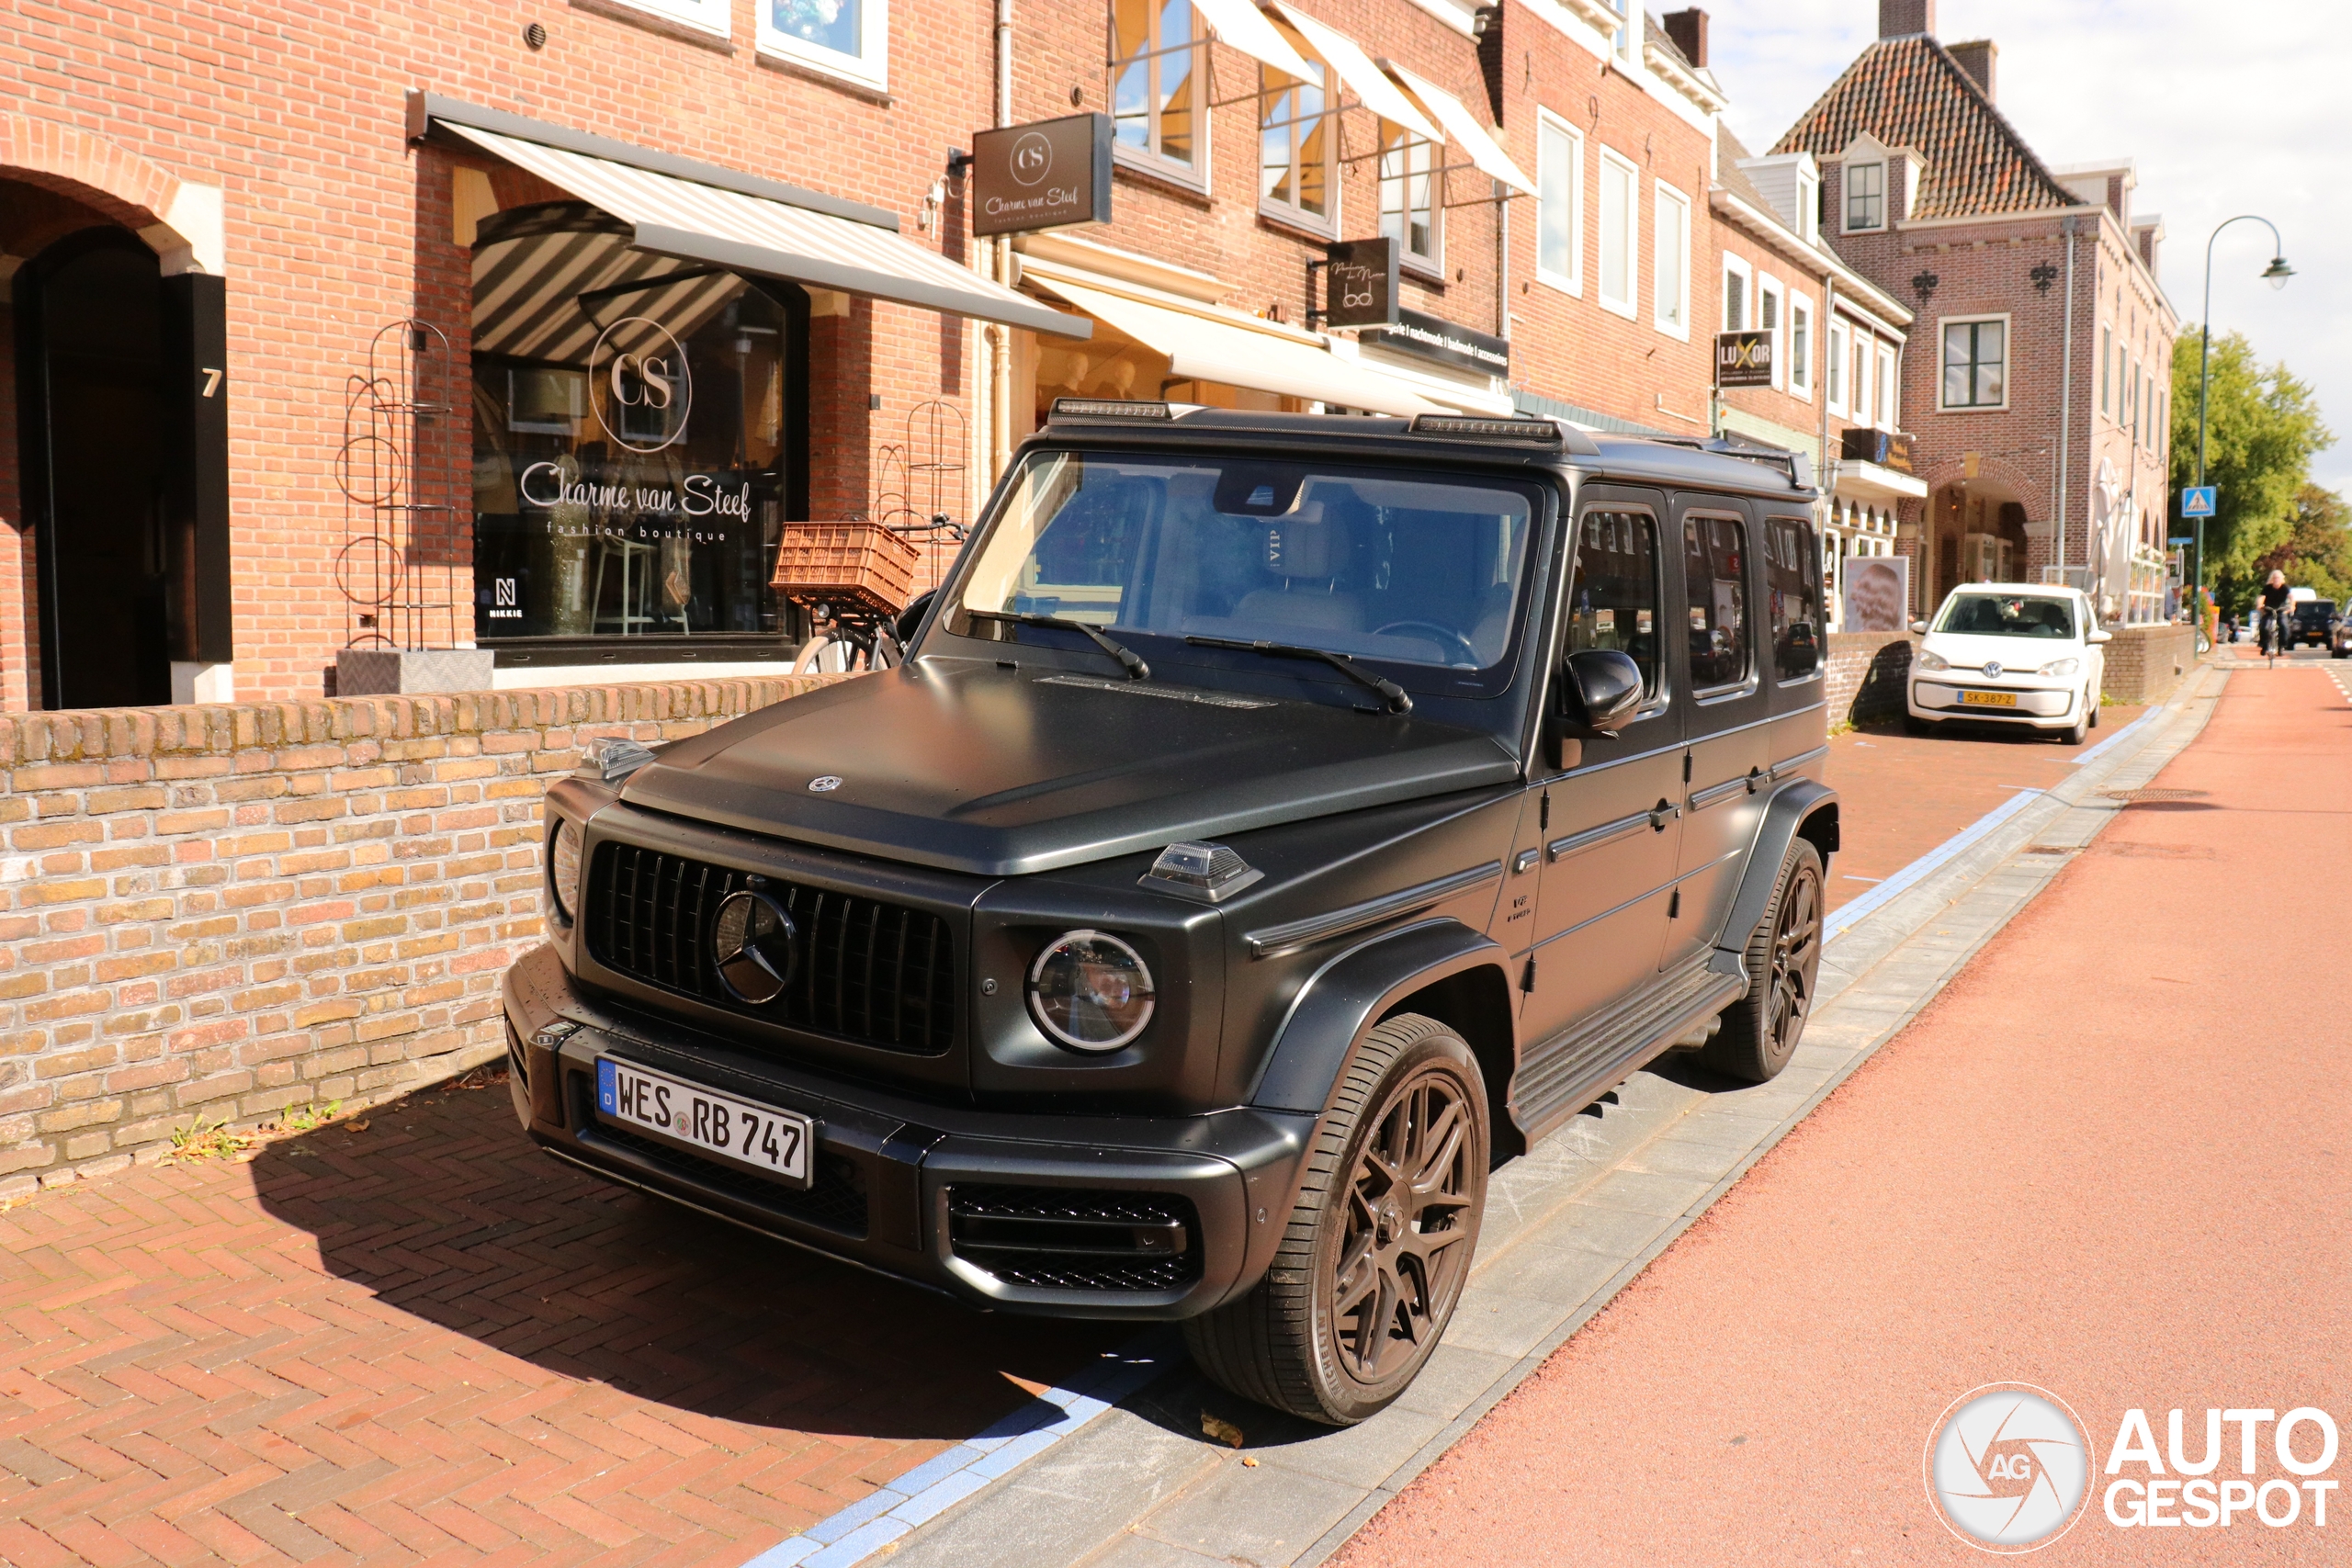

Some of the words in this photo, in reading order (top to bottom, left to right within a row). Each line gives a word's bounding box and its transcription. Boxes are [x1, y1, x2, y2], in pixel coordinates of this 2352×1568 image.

[1018, 145, 1044, 170] CS
[986, 196, 1026, 215] Charme
[1027, 196, 1045, 209] van
[1046, 186, 1079, 206] Steef
[1410, 327, 1443, 348] nachtmode
[1448, 336, 1475, 356] badmode
[1477, 349, 1509, 367] accessoires
[1721, 338, 1770, 368] LUXOR
[202, 367, 222, 398] 7
[611, 353, 672, 410] CS
[520, 461, 631, 509] Charme
[635, 487, 676, 512] van
[681, 474, 752, 523] Steef
[547, 521, 626, 537] fashion
[639, 525, 725, 543] boutique
[489, 609, 523, 618] NIKKIE
[1967, 693, 2012, 705] SK-387-Z
[604, 1092, 612, 1106] D
[617, 1072, 672, 1128] WES
[693, 1097, 730, 1148] RB
[741, 1111, 800, 1168] 747
[1317, 1315, 1342, 1396] MICHELIN
